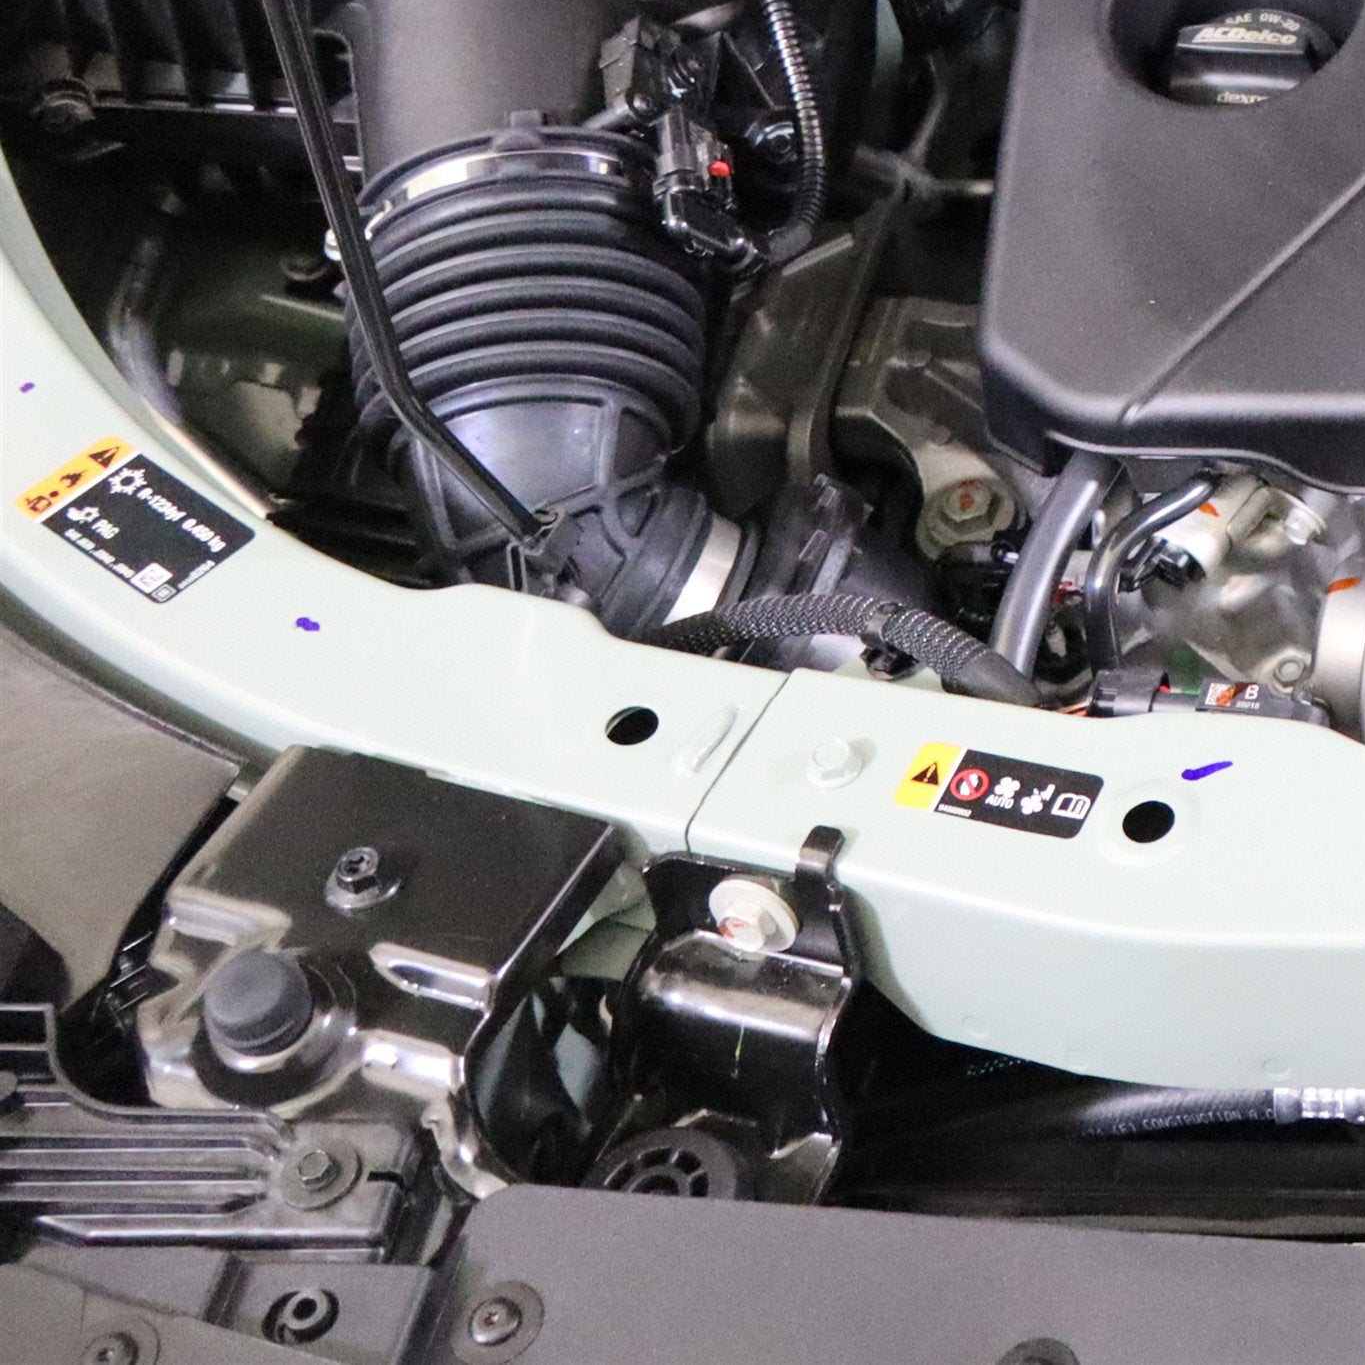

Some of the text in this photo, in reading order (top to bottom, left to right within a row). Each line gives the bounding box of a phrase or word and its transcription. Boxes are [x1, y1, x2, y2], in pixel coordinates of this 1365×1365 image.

[1225, 12, 1300, 32] SAE 0W-20
[1191, 26, 1297, 45] ACDelco
[91, 519, 120, 540] PAG
[136, 488, 227, 553] R-1234yf 0.450 kg
[1244, 684, 1259, 700] B
[984, 795, 1015, 809] AUTO
[1143, 1110, 1242, 1131] CONSTRUCTION
